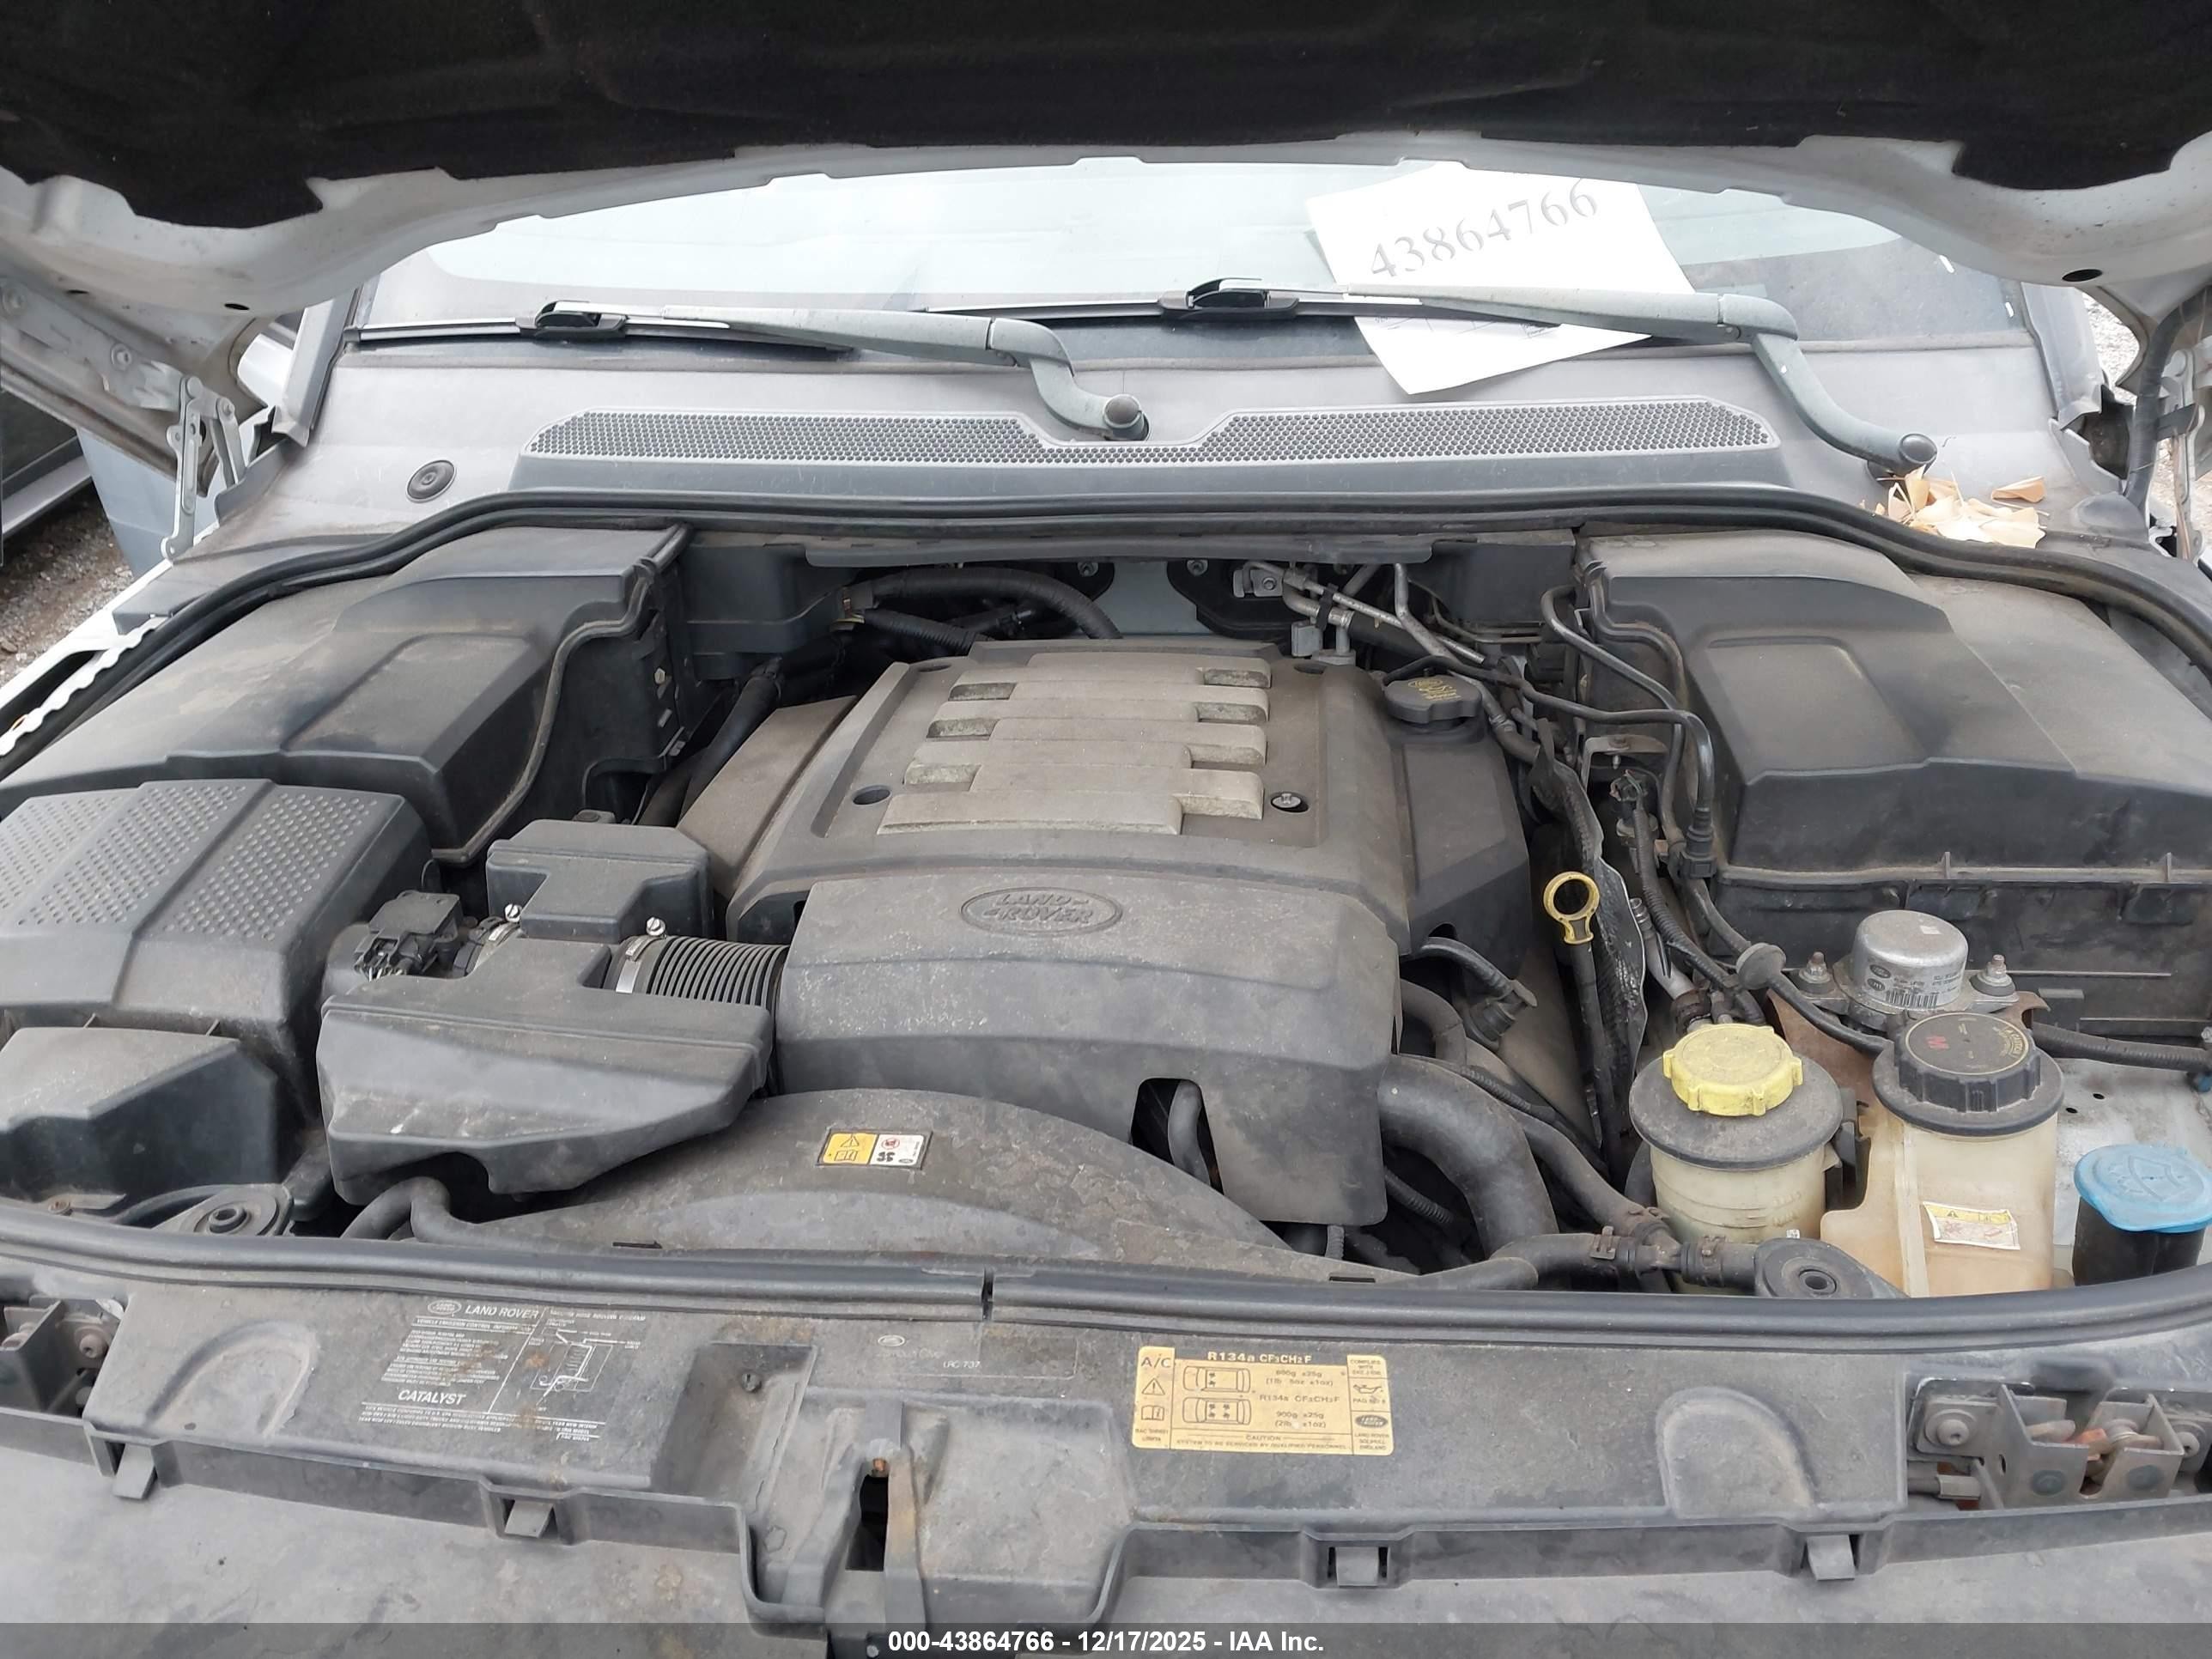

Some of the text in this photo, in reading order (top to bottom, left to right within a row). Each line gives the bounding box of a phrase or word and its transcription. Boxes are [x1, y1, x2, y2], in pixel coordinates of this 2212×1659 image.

[1370, 179, 1600, 279] 43864766
[465, 1304, 539, 1319] LAND ROVER
[1140, 1357, 1173, 1370] A/C
[1207, 1351, 1255, 1362] R134a
[398, 1389, 467, 1405] CATALYST
[1259, 1394, 1290, 1402] R134a
